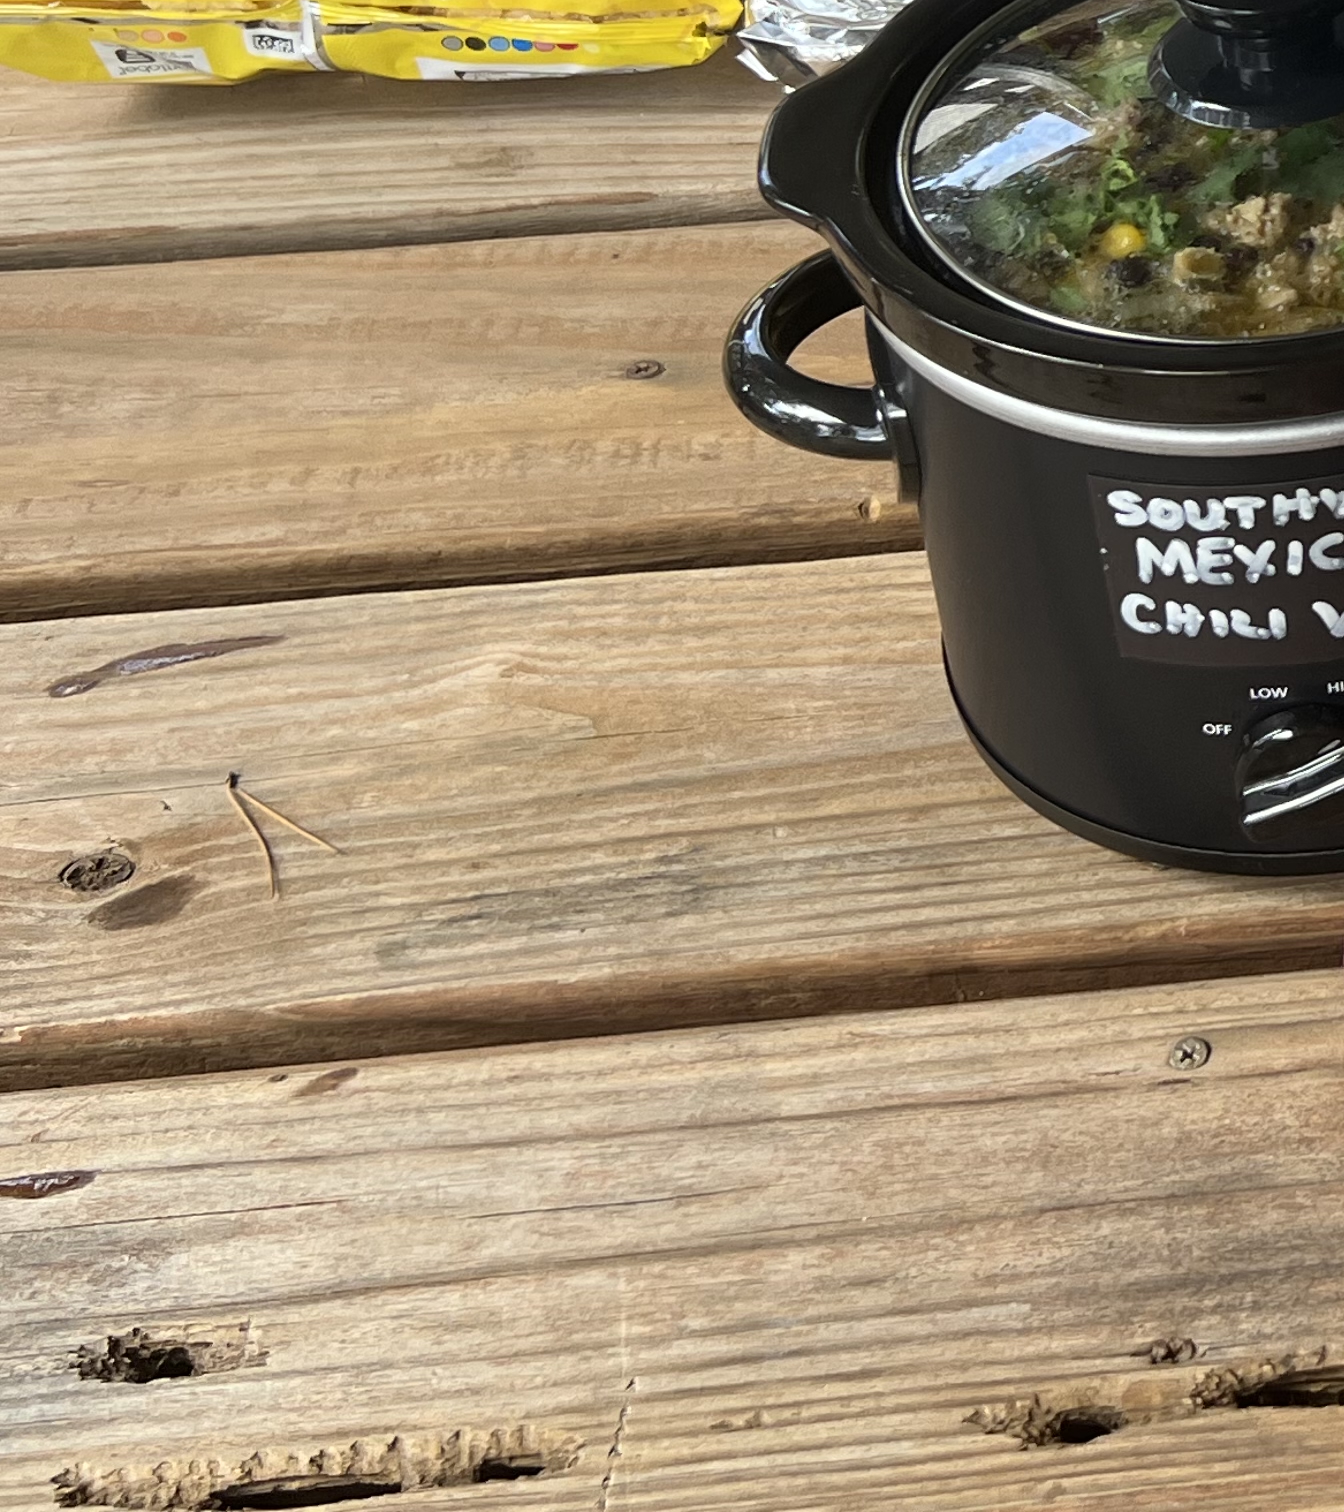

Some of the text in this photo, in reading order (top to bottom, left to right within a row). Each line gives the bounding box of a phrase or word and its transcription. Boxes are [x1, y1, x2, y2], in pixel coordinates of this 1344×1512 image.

[1120, 593, 1288, 640] CHILI
[1250, 687, 1288, 699] LOW
[1202, 723, 1233, 736] OFF
